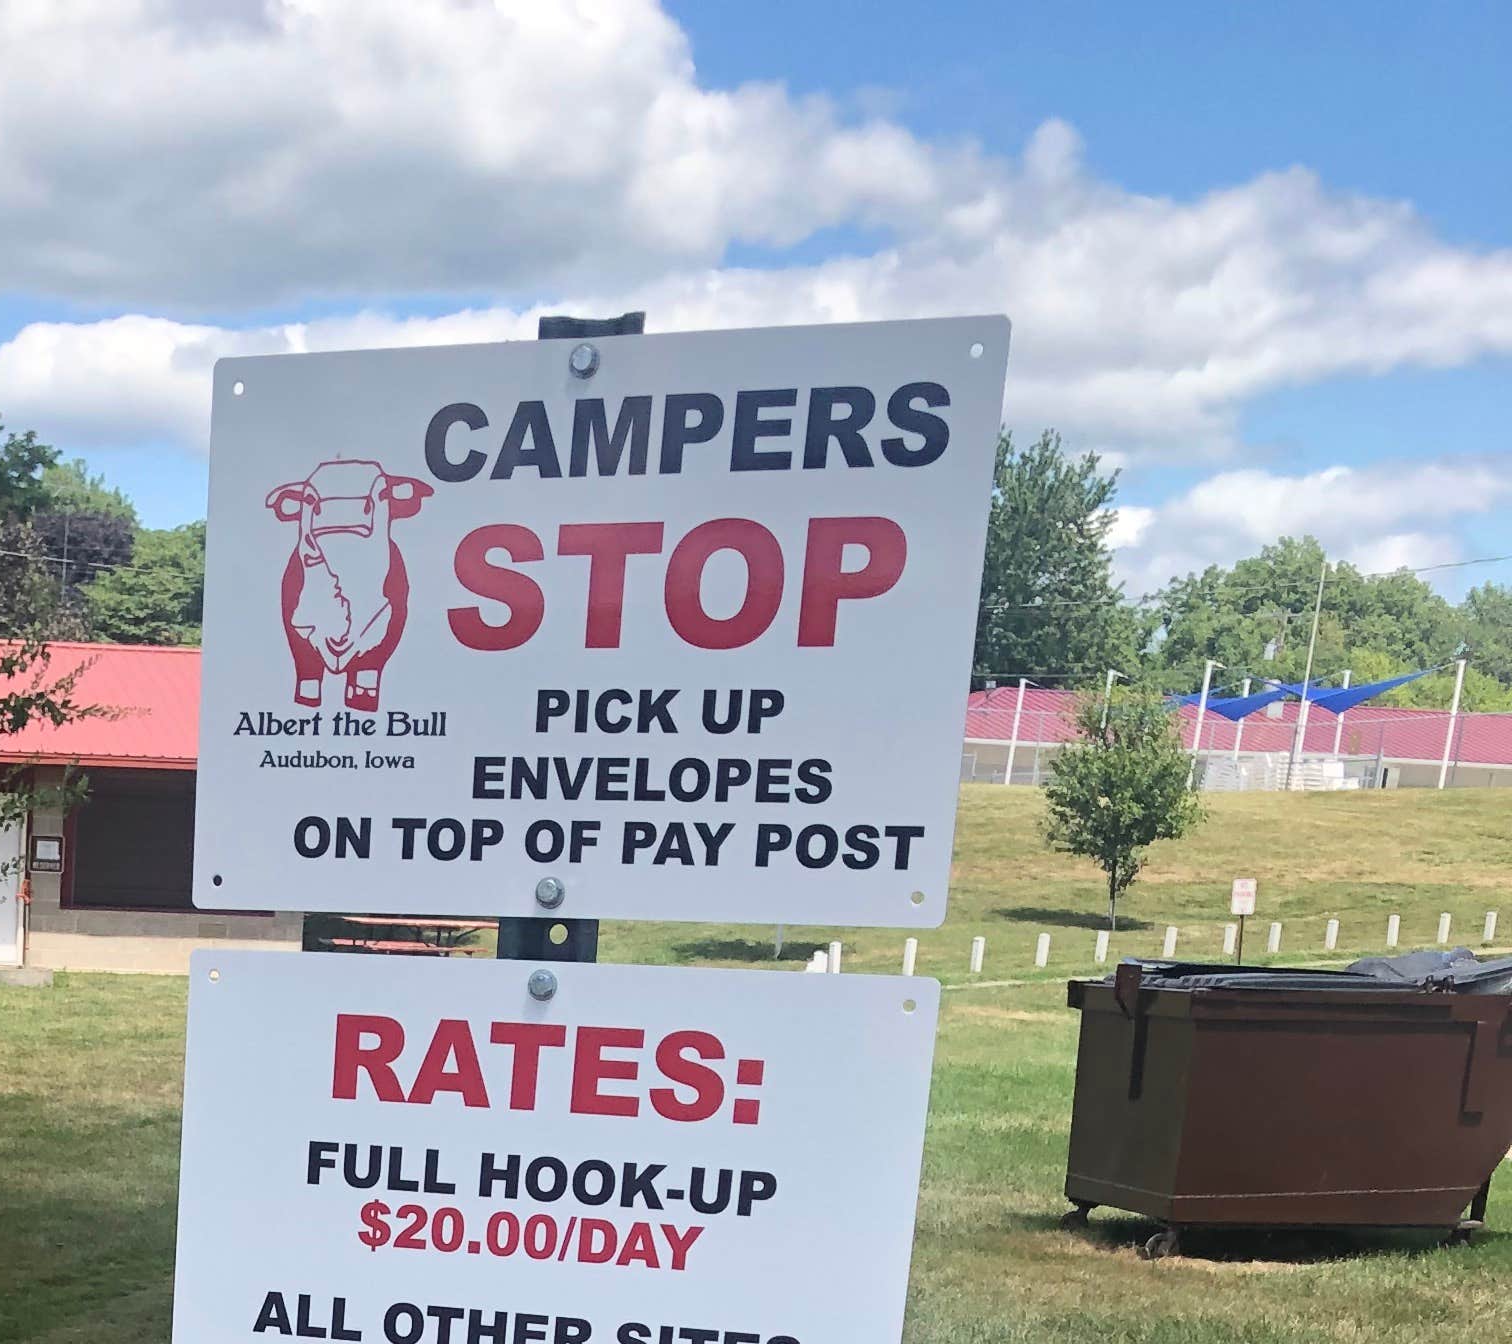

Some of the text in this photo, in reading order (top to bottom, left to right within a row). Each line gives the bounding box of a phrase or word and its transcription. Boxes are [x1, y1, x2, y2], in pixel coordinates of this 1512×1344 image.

[425, 382, 950, 482] CAMPERS
[448, 517, 906, 651] STOP
[234, 712, 446, 736] Albert the Bull
[536, 689, 784, 734] PICK UP
[260, 750, 414, 769] Audubon, Iowa
[473, 757, 832, 804] ENVELOPES
[294, 816, 924, 870] ON TOP OF PAY POST
[333, 1014, 764, 1124] RATES:
[307, 1141, 777, 1216] FULL HOOK-UP
[358, 1199, 704, 1270] $20.00/DAY
[253, 1292, 362, 1341] ALL
